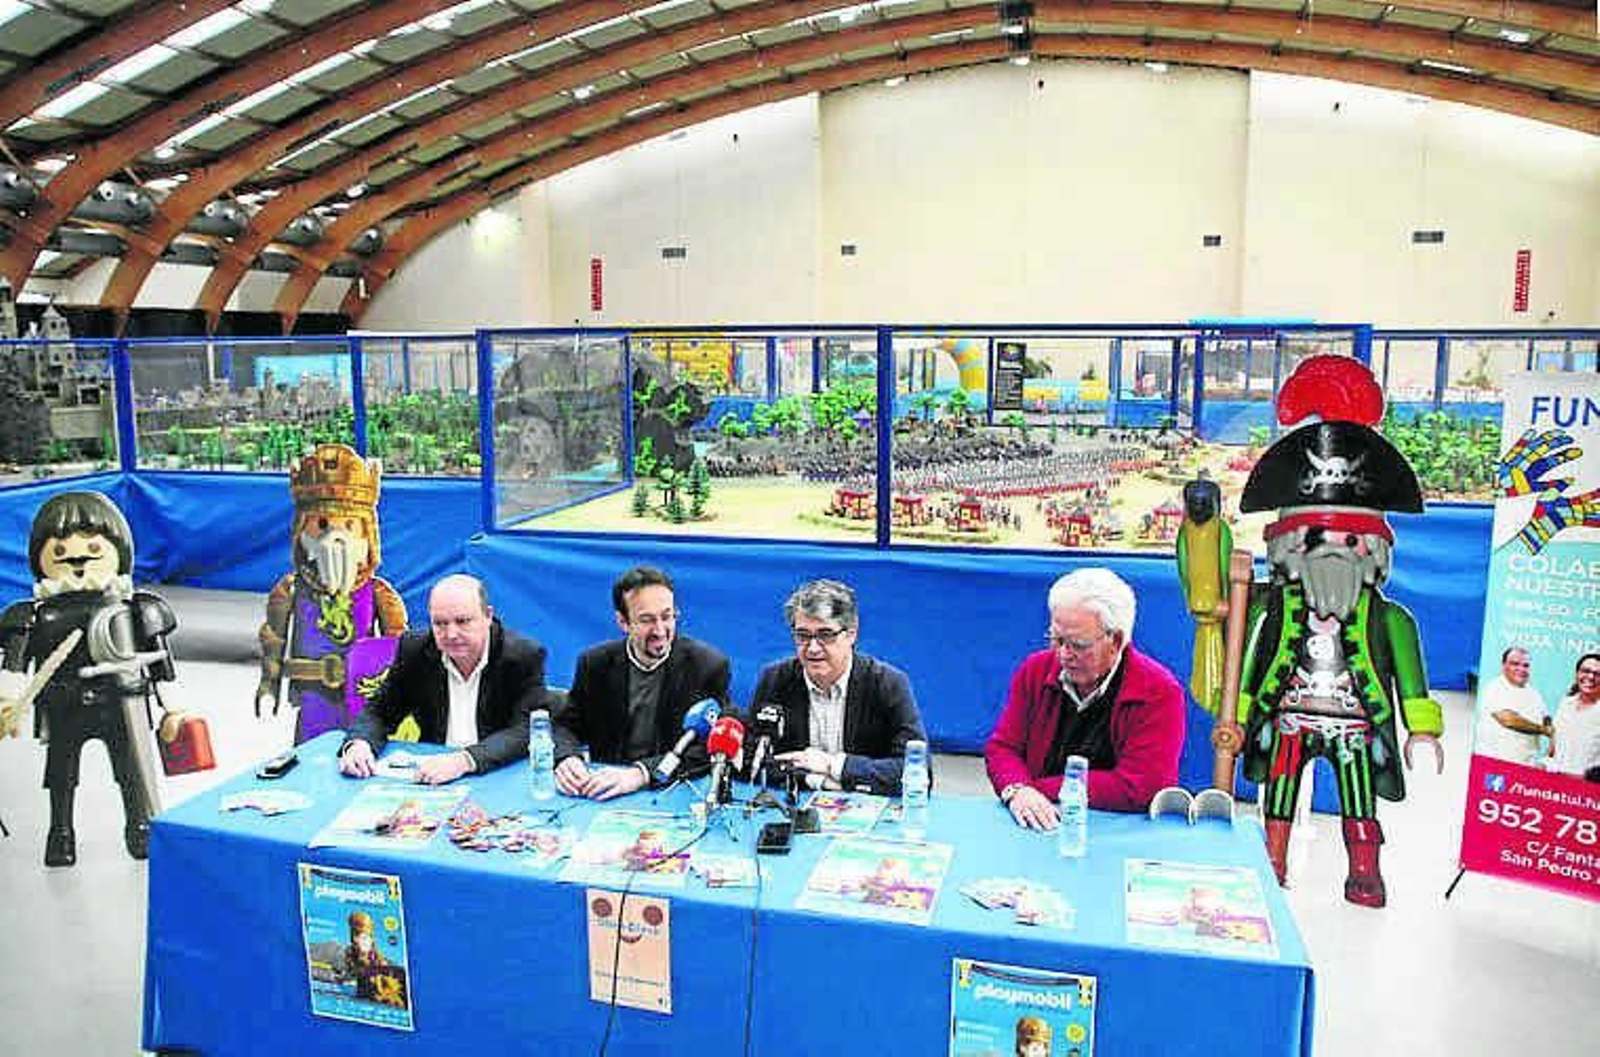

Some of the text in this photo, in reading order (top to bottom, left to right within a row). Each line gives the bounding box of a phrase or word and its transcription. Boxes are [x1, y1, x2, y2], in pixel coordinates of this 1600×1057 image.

[1531, 396, 1600, 427] FUN
[1478, 799, 1598, 844] 952 78
[1501, 850, 1592, 881] San Pedro
[973, 982, 1072, 1011] playmobil
